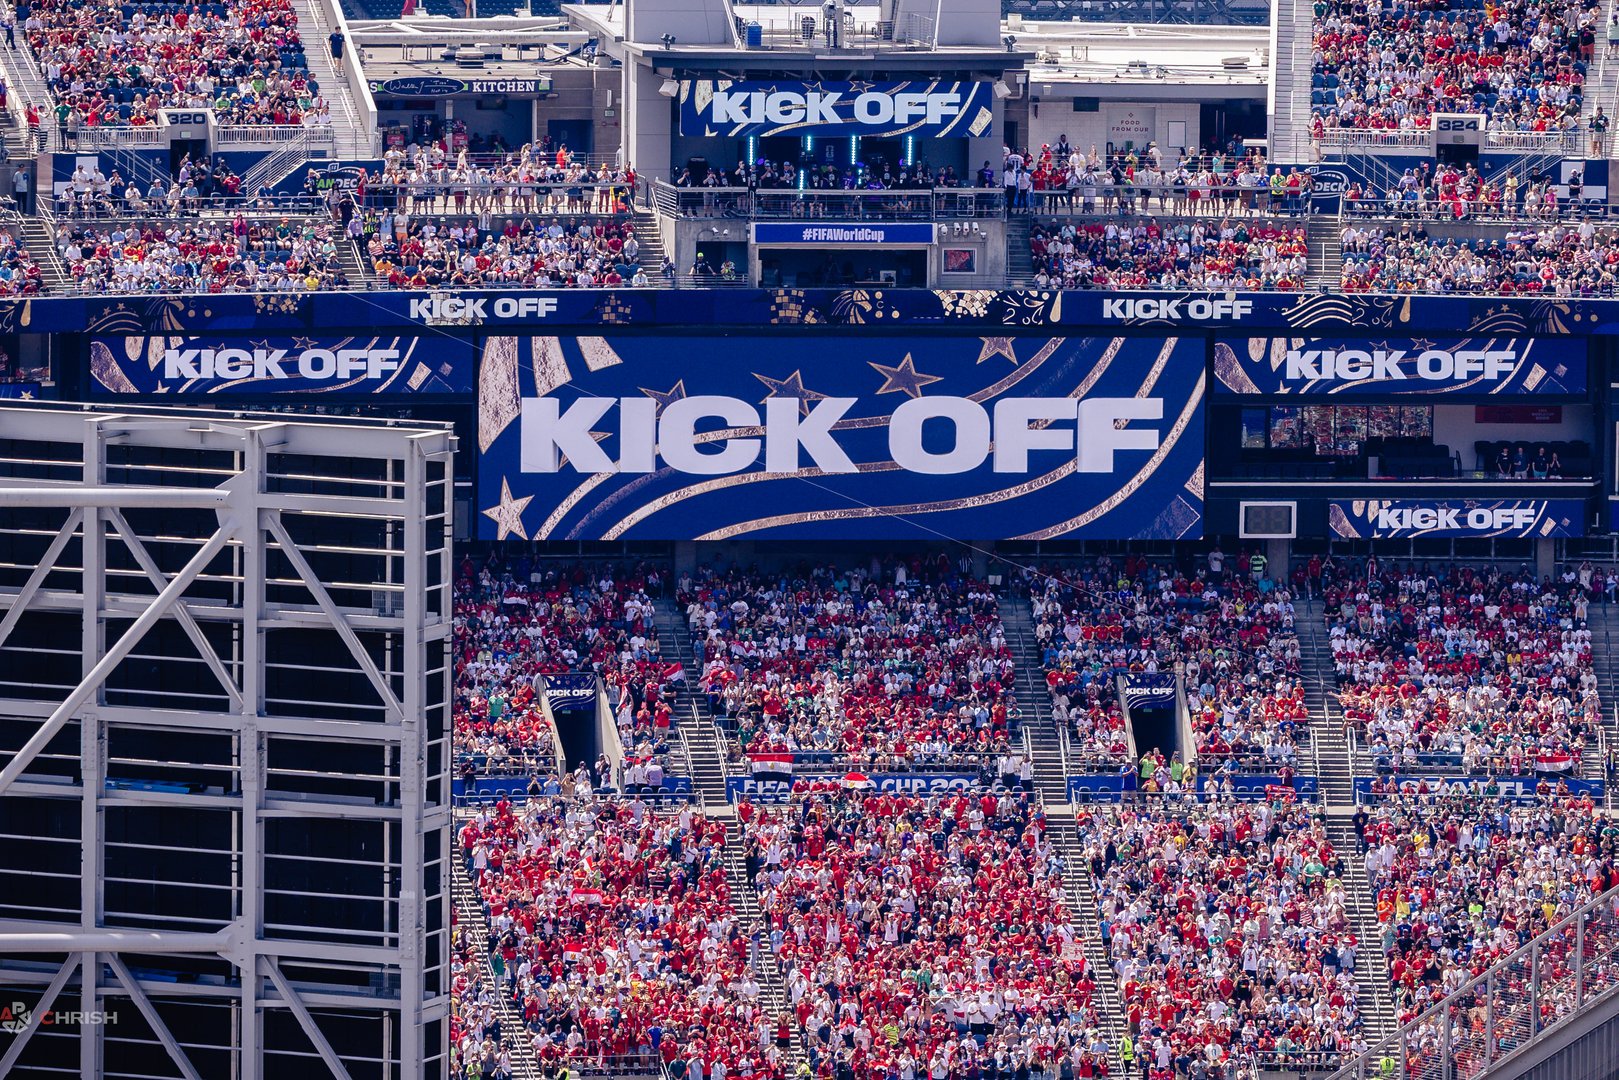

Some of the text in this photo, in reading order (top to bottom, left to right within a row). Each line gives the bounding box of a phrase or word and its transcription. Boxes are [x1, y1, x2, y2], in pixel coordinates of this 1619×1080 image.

[472, 81, 535, 92] KITCHEN
[712, 91, 961, 124] KICK OFF
[168, 113, 206, 124] 320
[1438, 119, 1479, 131] 324
[802, 228, 885, 243] #FIFAWorldCup
[409, 297, 558, 319] KICK OFF
[1103, 298, 1253, 320] KICK OFF
[164, 349, 400, 380] KICK OFF
[1286, 350, 1516, 381] KICK OFF
[520, 395, 1164, 475] KICK OFF
[1378, 508, 1536, 530] KICK OFF
[545, 689, 593, 697] KICK OFF
[1125, 687, 1173, 695] KICK OFF
[743, 779, 790, 794] FIFA
